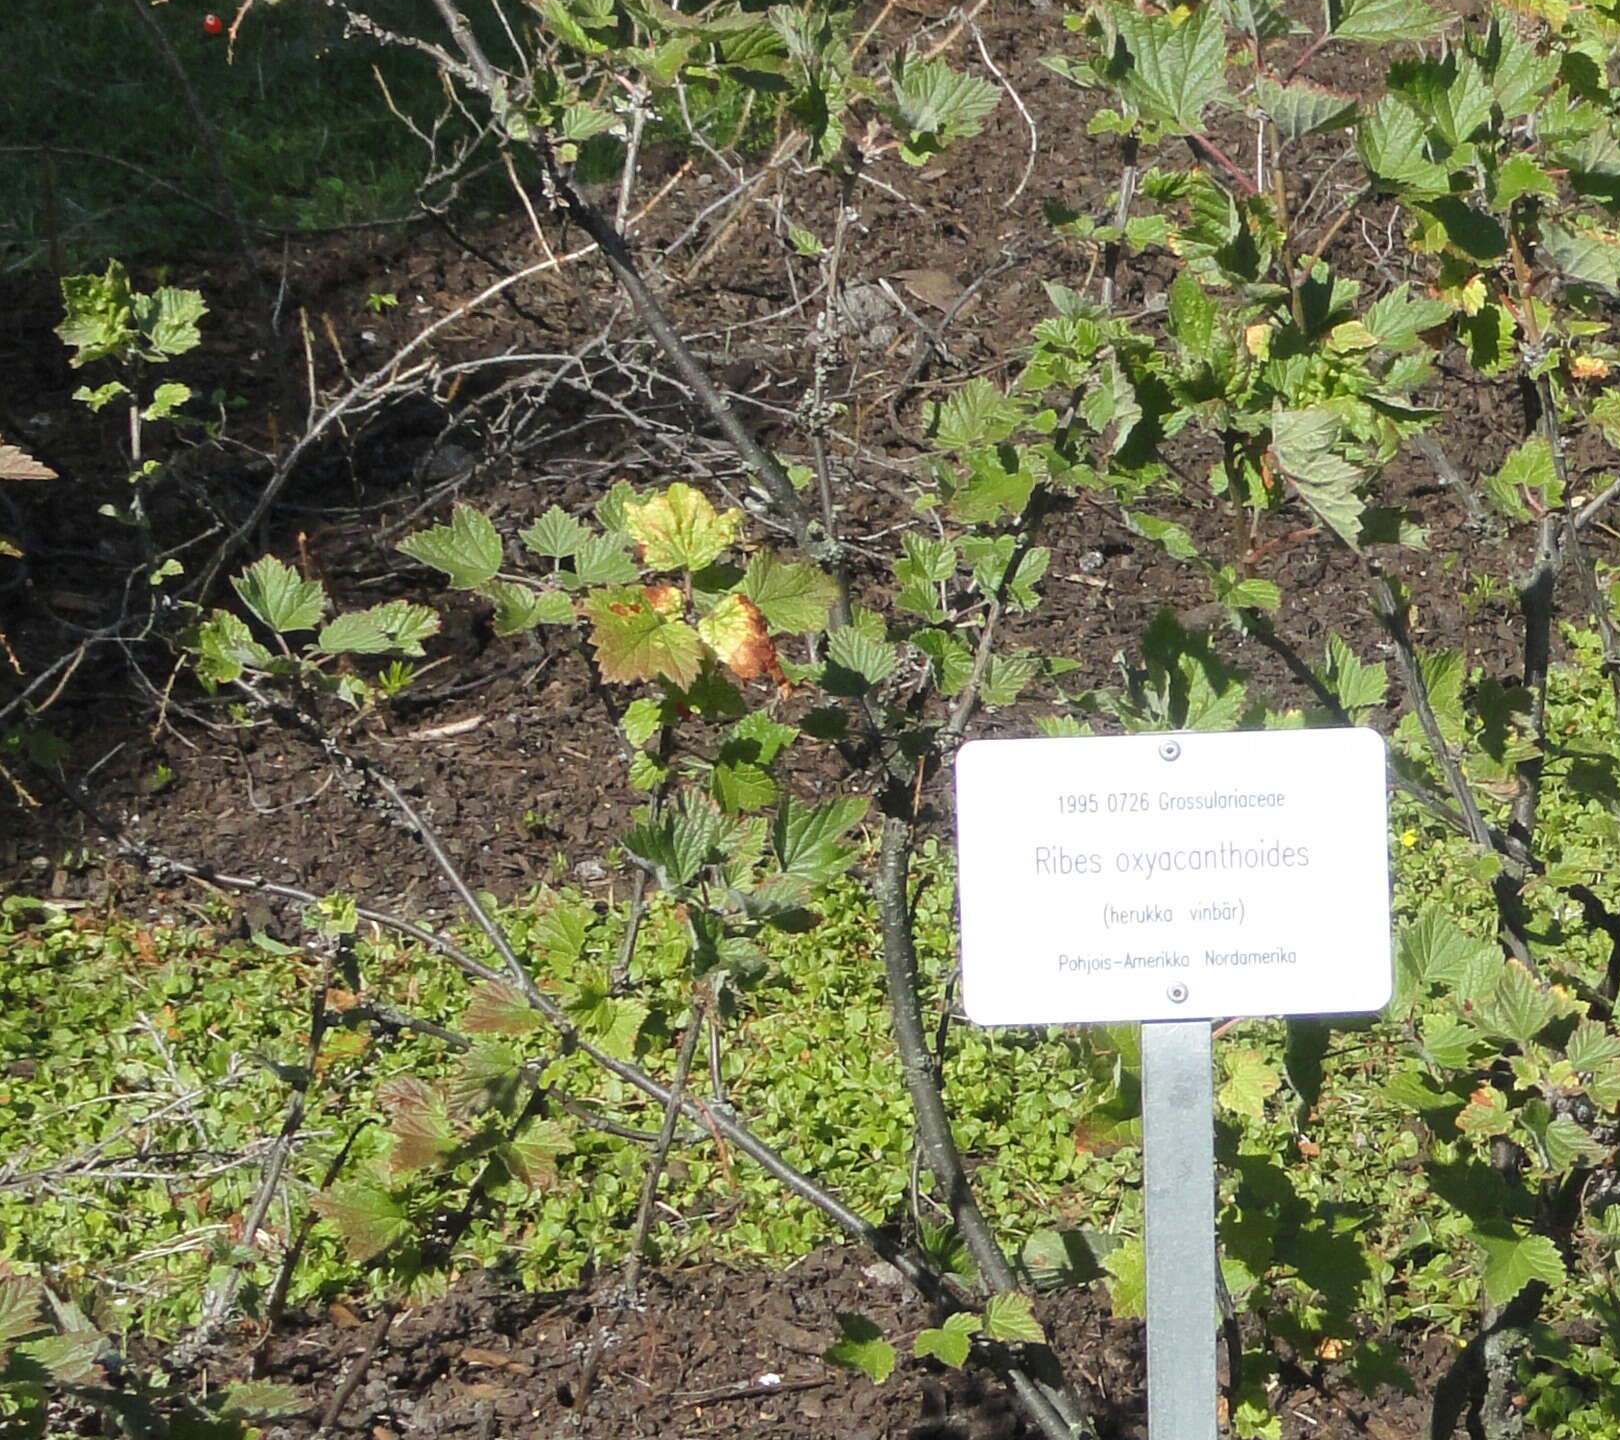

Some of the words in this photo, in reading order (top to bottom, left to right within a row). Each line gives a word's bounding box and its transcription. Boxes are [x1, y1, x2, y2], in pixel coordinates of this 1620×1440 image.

[1058, 794, 1099, 814] 1995
[1107, 792, 1150, 812] 0726
[1159, 788, 1286, 810] Grossulariaceae
[1035, 845, 1103, 875] Ribes
[1116, 839, 1310, 881] oxyacanthoides
[1103, 902, 1173, 929] (herukka
[1189, 898, 1246, 925] vinbär)
[1058, 951, 1190, 975] Pohjois-Amerikka
[1204, 947, 1297, 967] Nordamerika
